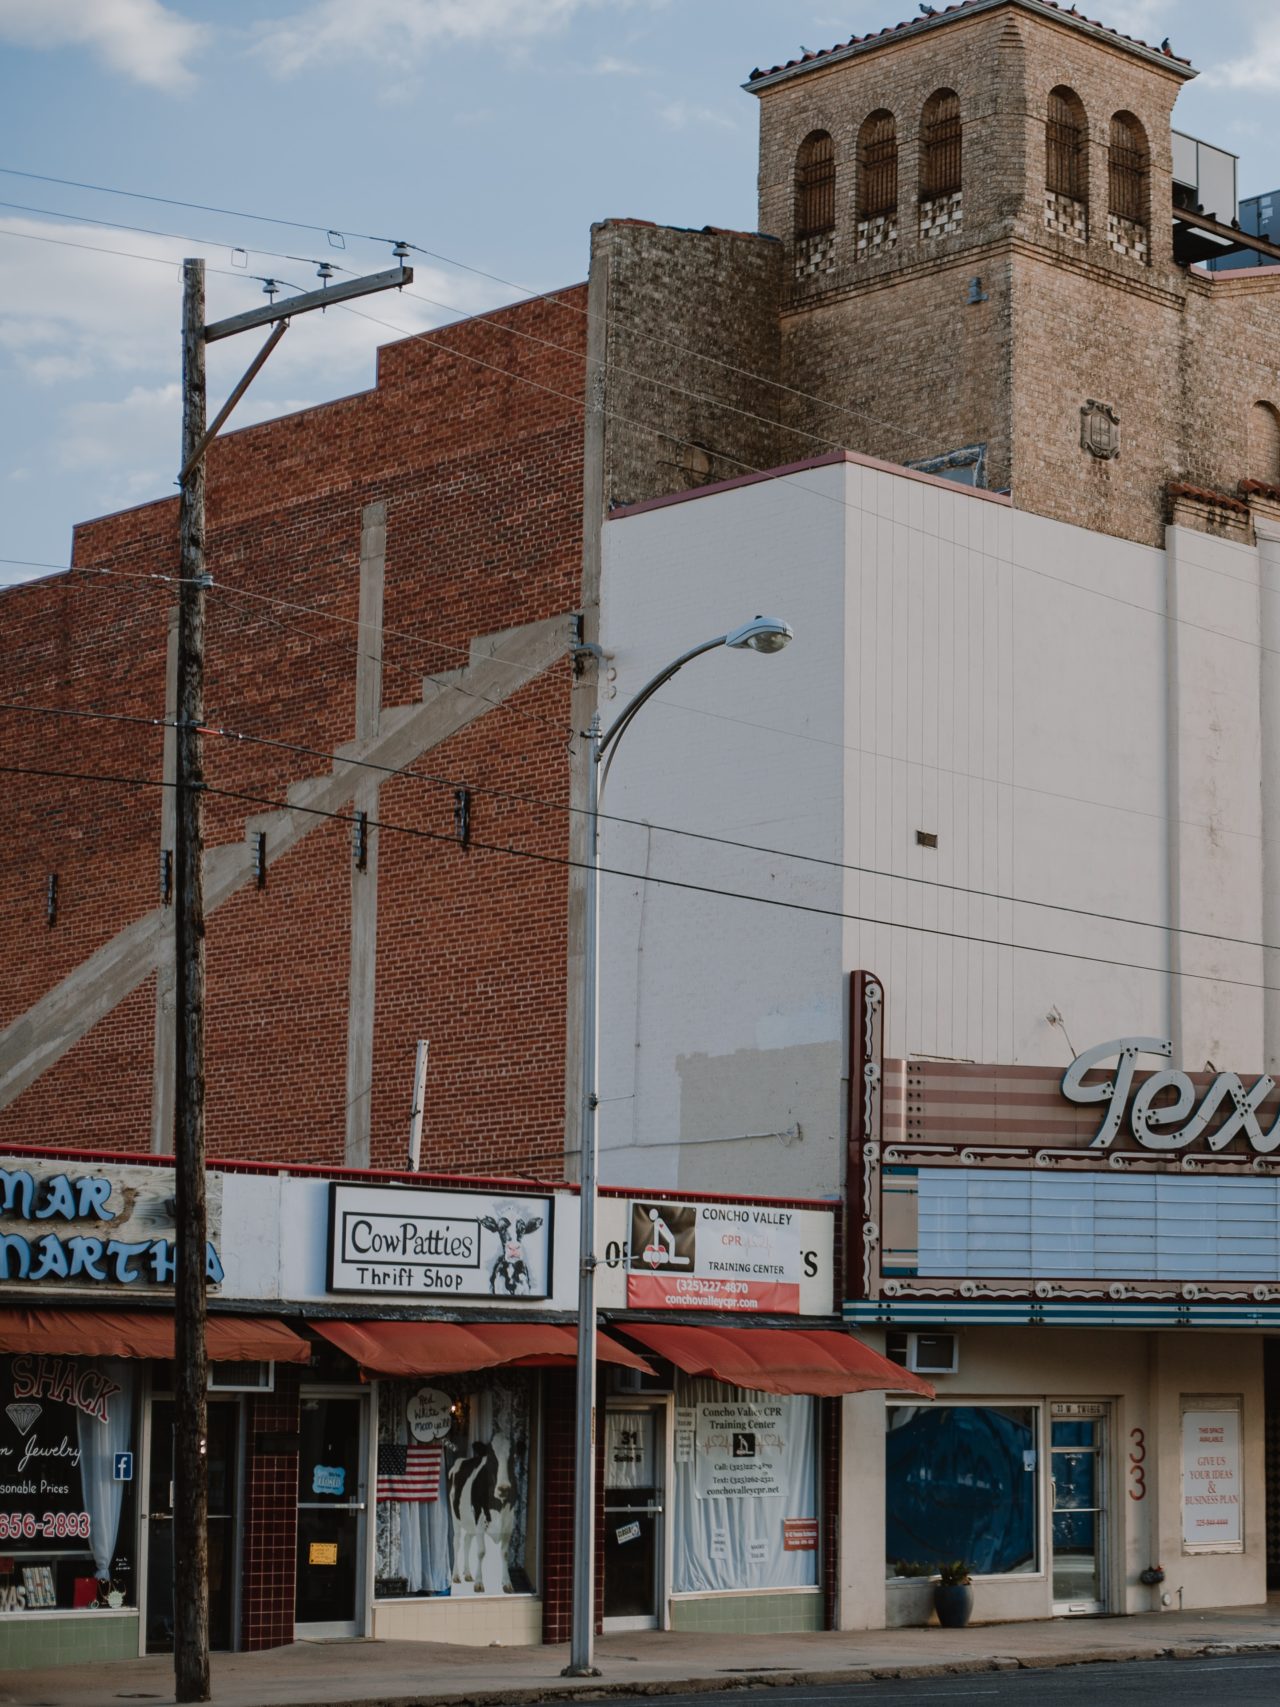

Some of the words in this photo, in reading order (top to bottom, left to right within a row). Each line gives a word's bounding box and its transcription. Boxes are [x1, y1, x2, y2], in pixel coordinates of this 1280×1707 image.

[702, 1208, 750, 1223] CONCHO
[752, 1211, 793, 1226] VALLEY
[721, 1234, 742, 1247] CPR
[708, 1261, 751, 1273] TRAINING
[752, 1263, 785, 1275] CENTER
[356, 1267, 414, 1287] Thrift
[423, 1268, 463, 1290] Shop
[676, 1278, 749, 1294] (325)227-4870
[665, 1294, 758, 1309] conchovalleycpr.com
[12, 1356, 121, 1424] SHACK
[702, 1407, 735, 1417] Concho
[763, 1407, 783, 1417] CPR
[710, 1420, 747, 1430] Training
[748, 1419, 776, 1429] Center
[621, 1431, 638, 1445] 31
[17, 1434, 82, 1472] Jewelry
[1197, 1456, 1216, 1466] GIVE
[1217, 1456, 1226, 1465] US
[1189, 1470, 1210, 1480] YOUR
[1211, 1469, 1233, 1479] IDEAS
[40, 1479, 70, 1494] Prices
[1207, 1480, 1216, 1494] &
[1185, 1495, 1219, 1505] BUSINESS
[1220, 1494, 1239, 1504] PLAN
